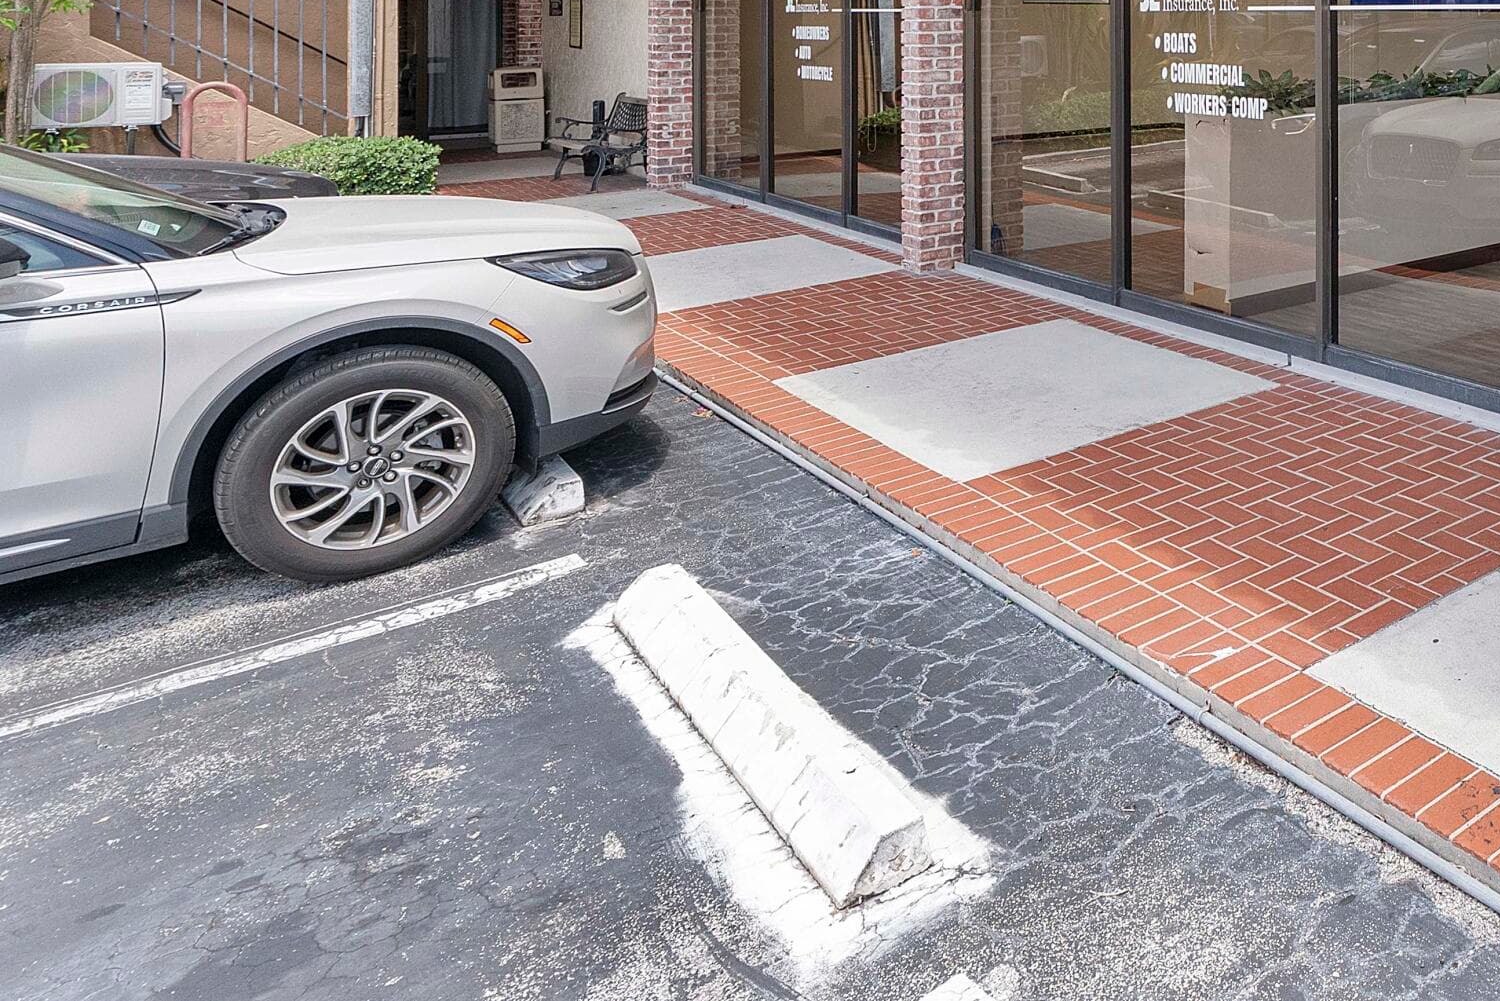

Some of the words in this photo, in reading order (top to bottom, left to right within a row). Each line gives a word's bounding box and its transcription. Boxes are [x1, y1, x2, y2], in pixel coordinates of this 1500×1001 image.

[1163, 32, 1197, 54] BOATS
[1170, 62, 1245, 87] COMMERCIAL
[1174, 92, 1227, 117] WORKERS
[1231, 97, 1268, 120] COMP
[39, 296, 146, 314] CORSAIR
